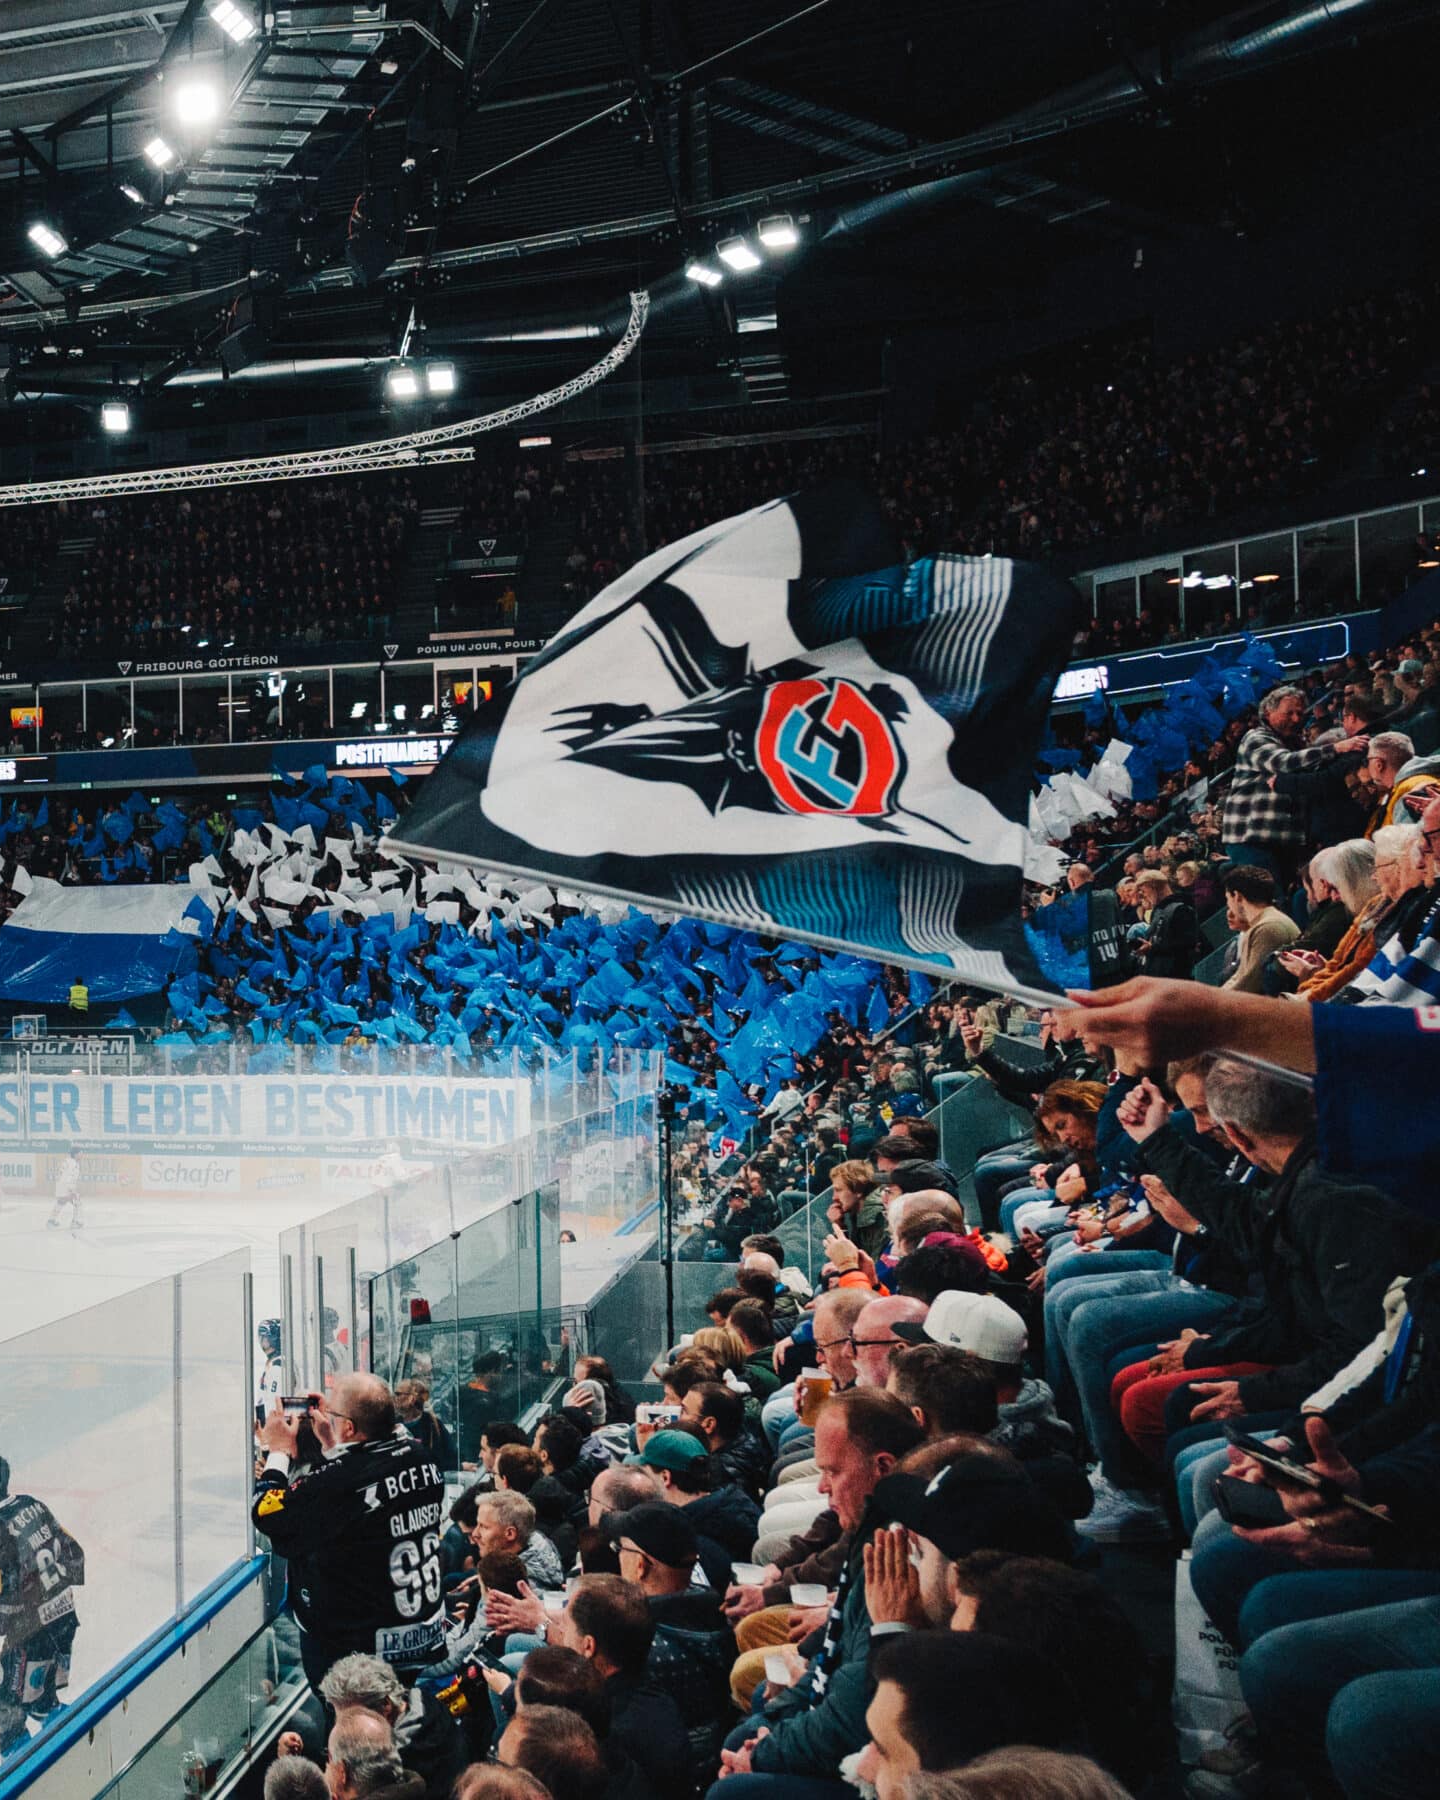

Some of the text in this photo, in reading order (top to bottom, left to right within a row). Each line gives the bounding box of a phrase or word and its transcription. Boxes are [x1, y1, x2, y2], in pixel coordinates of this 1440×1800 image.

[417, 645, 447, 654] POUR
[450, 644, 466, 652] UN
[505, 640, 535, 649] POUR
[103, 1083, 241, 1135] LEBEN
[264, 1083, 515, 1142] BESTIMMEN
